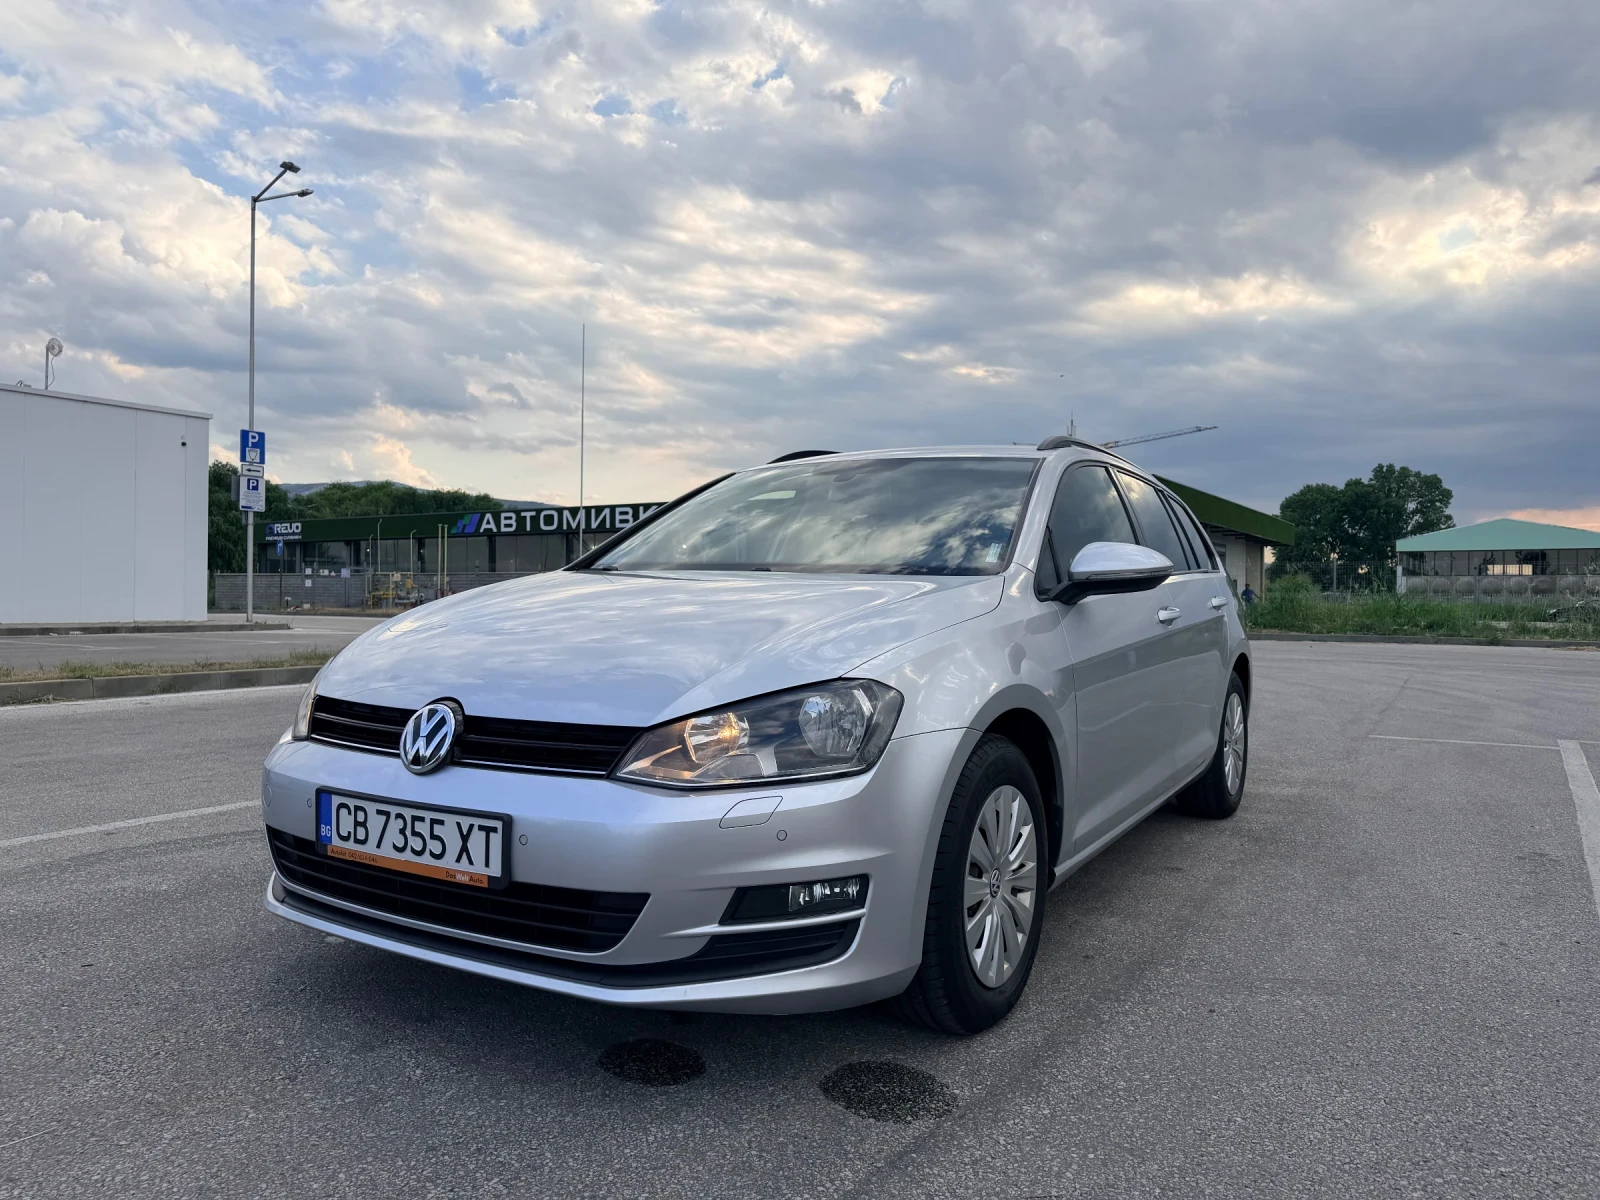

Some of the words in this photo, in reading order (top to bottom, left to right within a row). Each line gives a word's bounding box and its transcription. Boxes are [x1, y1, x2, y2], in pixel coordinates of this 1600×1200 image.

[249, 432, 259, 447] P
[250, 480, 257, 490] P
[400, 704, 456, 774] VW
[320, 824, 331, 837] BG
[455, 821, 499, 868] XT
